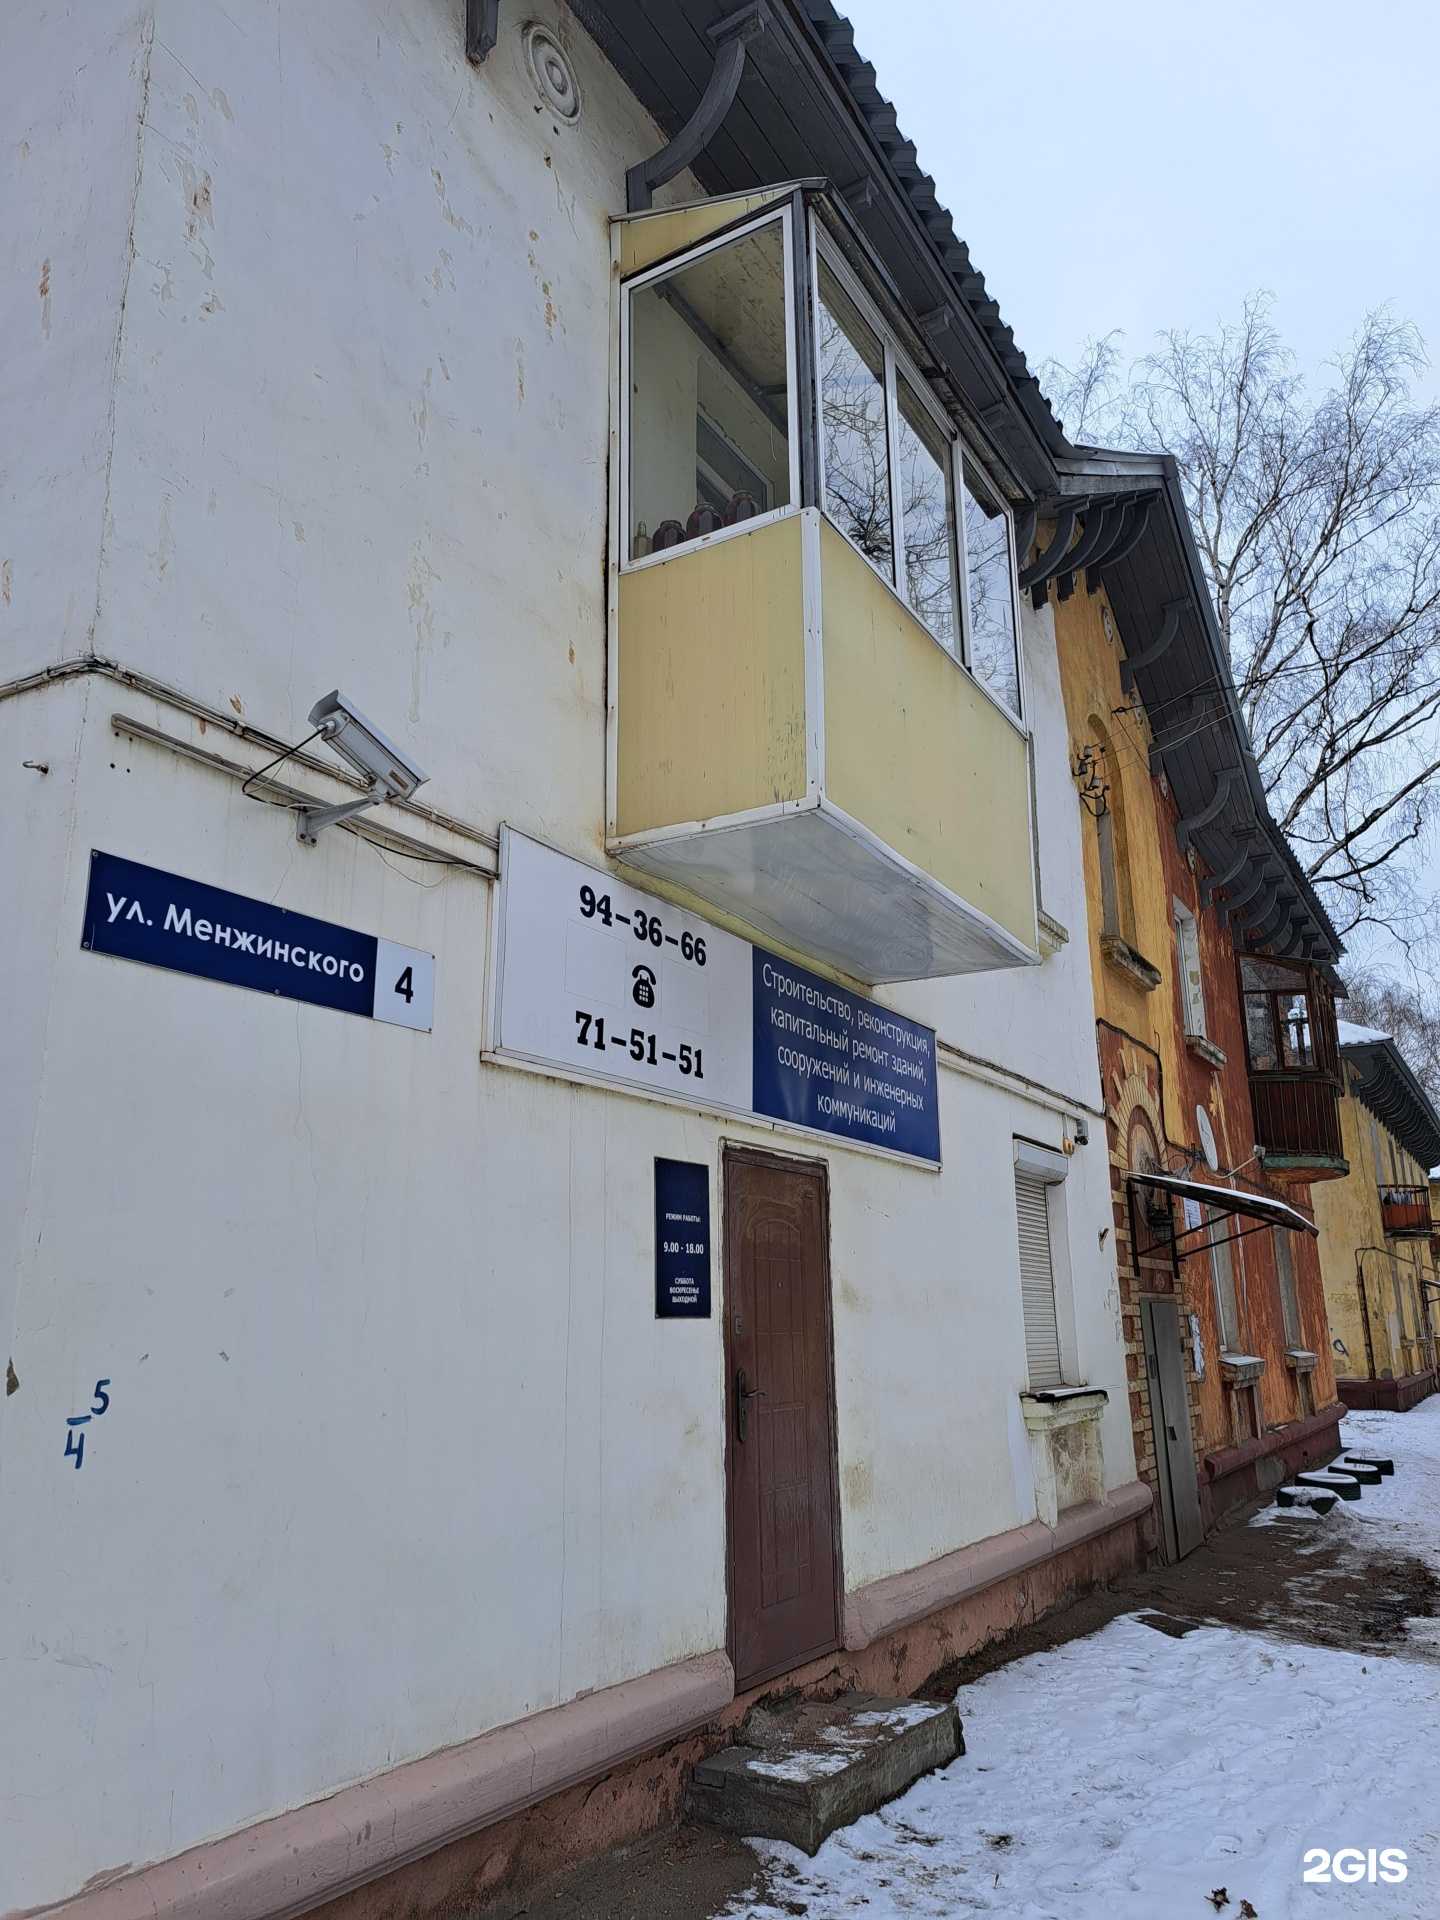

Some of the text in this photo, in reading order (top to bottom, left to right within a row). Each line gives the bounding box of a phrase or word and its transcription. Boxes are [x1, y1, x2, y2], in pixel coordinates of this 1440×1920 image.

[105, 892, 414, 1004] ул. Менжинского 4
[579, 885, 707, 967] 94-36-66
[575, 1010, 704, 1079] 71-51-51
[762, 963, 930, 1058] Строительство, реконструкция,
[770, 1006, 928, 1086] капитальный ремонт зданий,
[777, 1046, 924, 1111] сооружений и инженерных
[817, 1094, 896, 1133] коммуникаций
[663, 1241, 679, 1253] 9.00
[685, 1243, 704, 1255] 18.00
